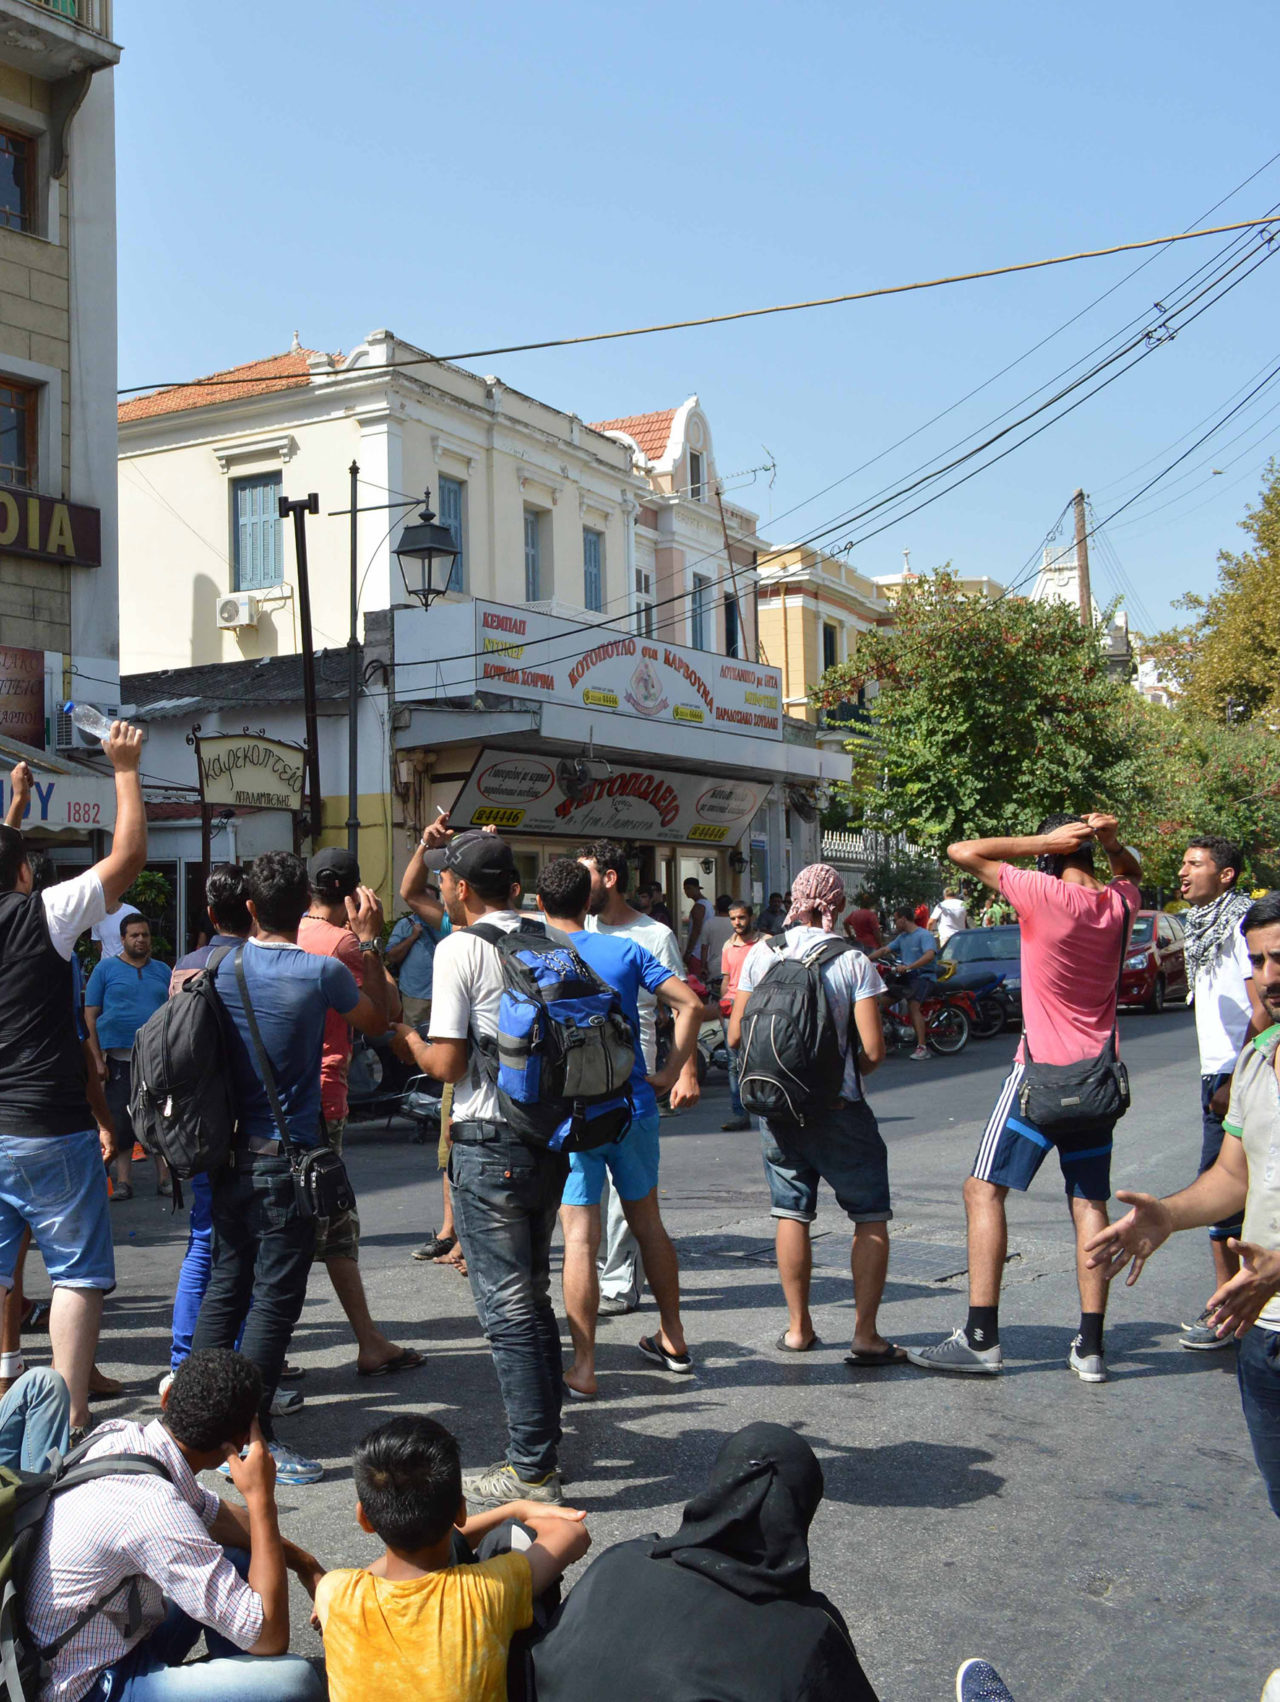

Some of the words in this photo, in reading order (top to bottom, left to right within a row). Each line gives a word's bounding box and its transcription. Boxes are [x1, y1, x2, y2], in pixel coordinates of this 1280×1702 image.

[482, 612, 527, 635] ΚΕΜΠΑΠ
[483, 638, 525, 660] ΝΤΟΝΕΡ
[568, 639, 636, 689] ΚΟΤΟΠΟΥΛΟ
[664, 648, 714, 714] ΚΑΡΒΟΥΝΑ
[67, 801, 101, 825] 1882
[485, 809, 522, 823] 44446
